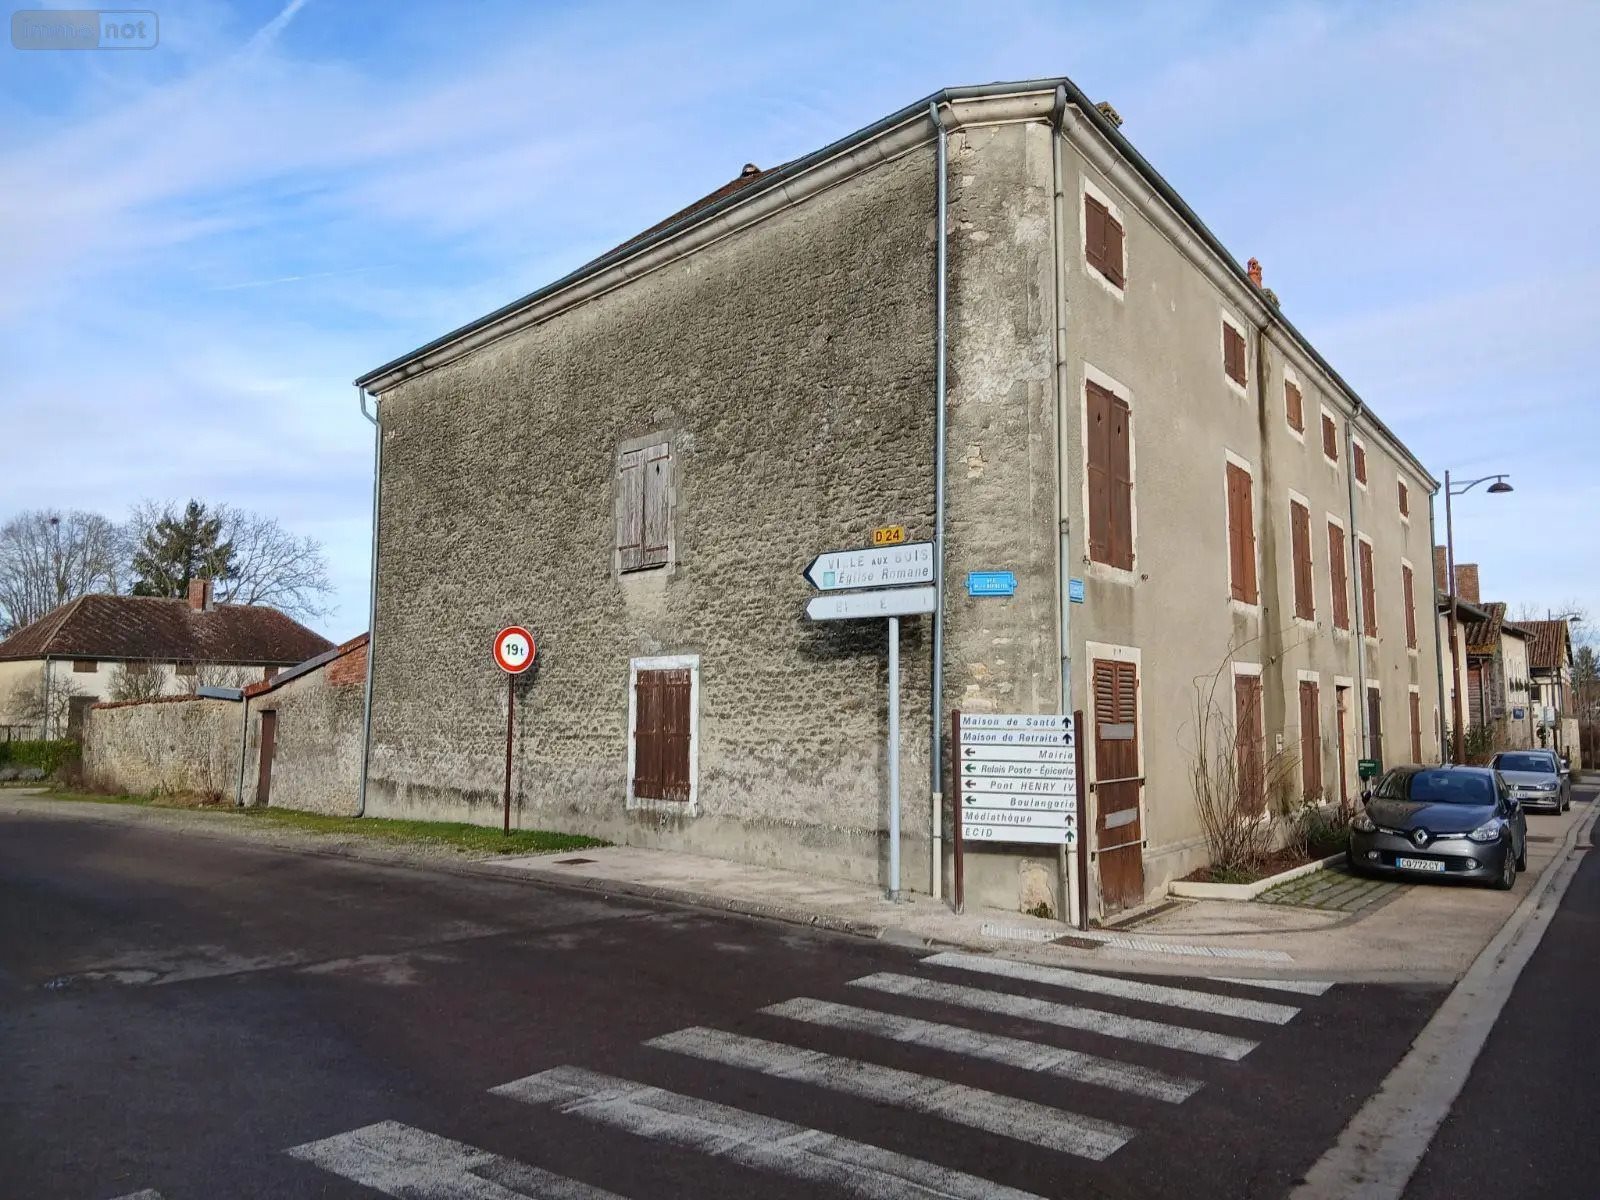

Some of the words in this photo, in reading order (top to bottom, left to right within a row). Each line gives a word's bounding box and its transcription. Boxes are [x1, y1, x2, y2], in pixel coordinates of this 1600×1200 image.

[828, 555, 864, 569] VILE
[871, 557, 888, 566] AUX
[962, 717, 999, 726] Maison
[1006, 717, 1018, 726] de
[1026, 718, 1056, 727] Santé
[963, 732, 997, 741] Maison
[1002, 733, 1013, 742] de
[1019, 733, 1058, 743] Retraite
[1038, 750, 1073, 759] Mairie
[981, 765, 1006, 773] Relais
[1008, 765, 1032, 774] Poste
[1040, 764, 1074, 776] Épicerie
[990, 780, 1013, 790] Pont
[1020, 781, 1056, 791] HENRY
[1063, 783, 1074, 792] IV
[1010, 797, 1075, 809] Boulangerie
[965, 812, 1032, 824] Médiathèque
[965, 828, 993, 838] ECID
